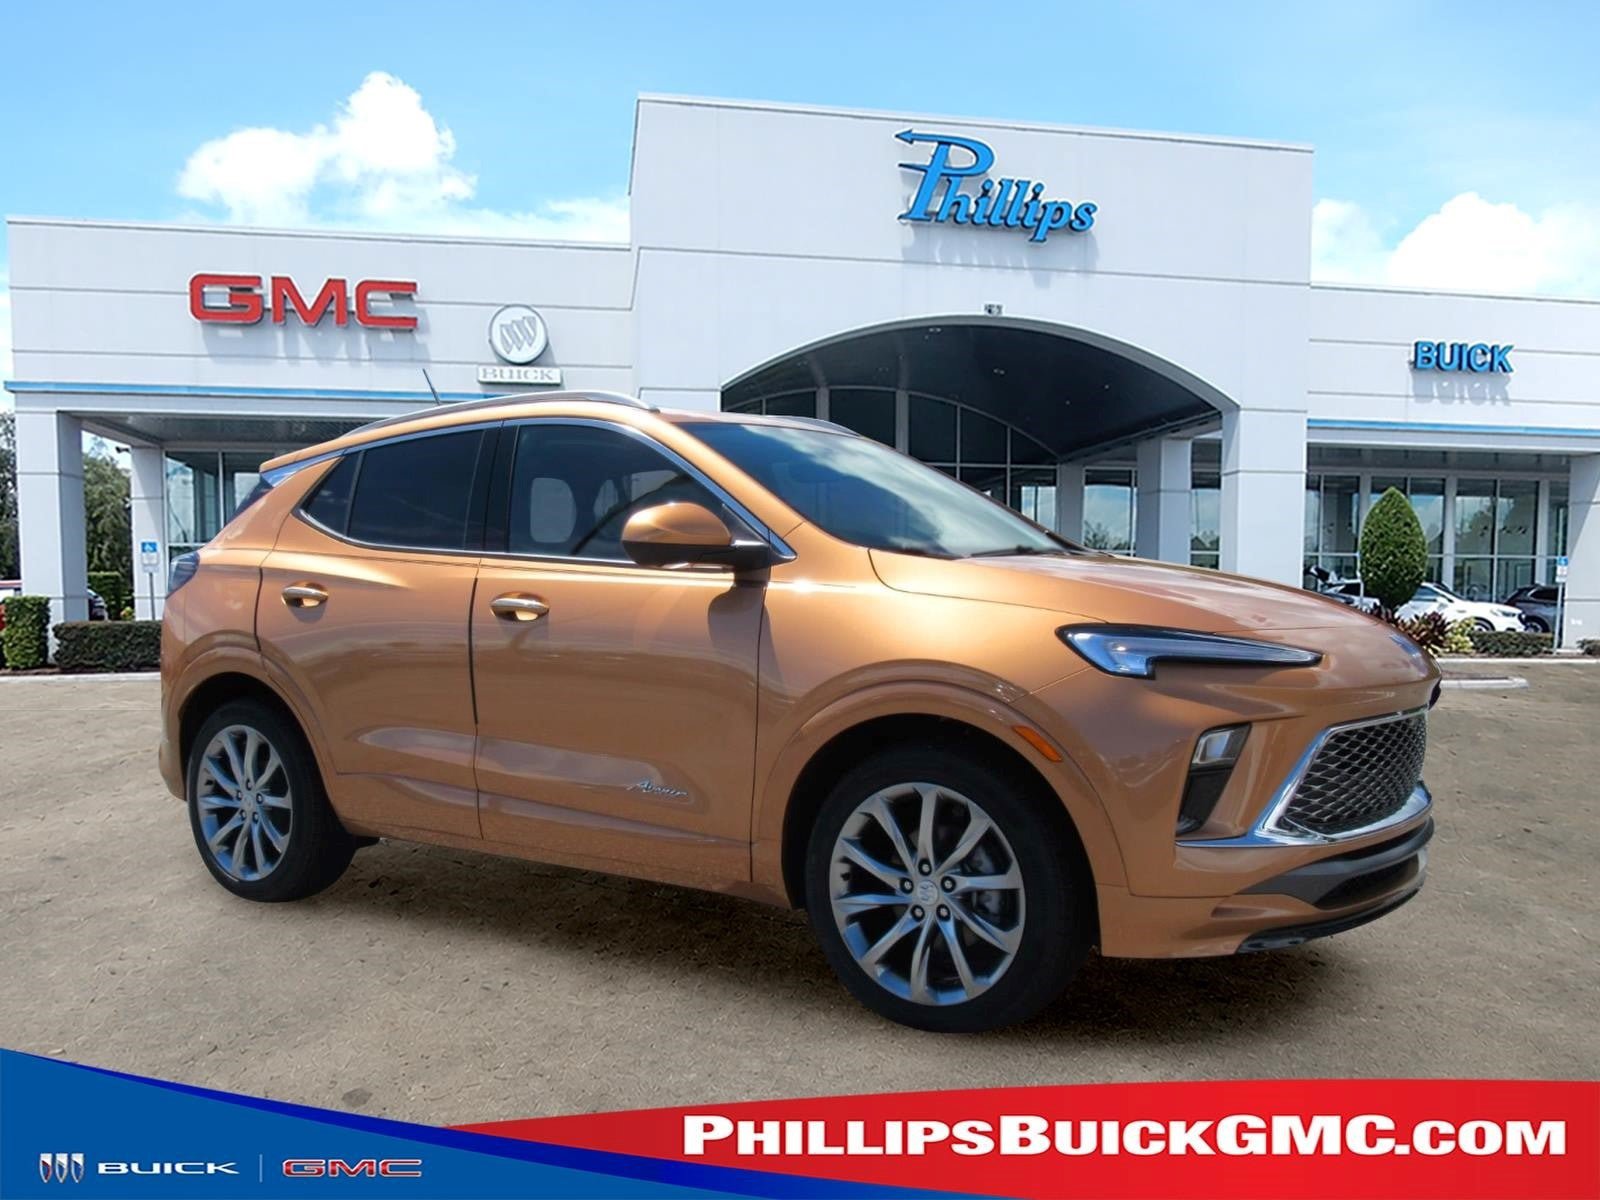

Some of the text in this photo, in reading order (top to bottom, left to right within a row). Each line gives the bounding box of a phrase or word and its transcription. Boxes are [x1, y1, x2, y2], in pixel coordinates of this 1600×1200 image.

[895, 129, 1098, 242] Phillips
[189, 273, 418, 331] GMC
[482, 367, 554, 380] BUICK
[1414, 341, 1515, 373] BUICK
